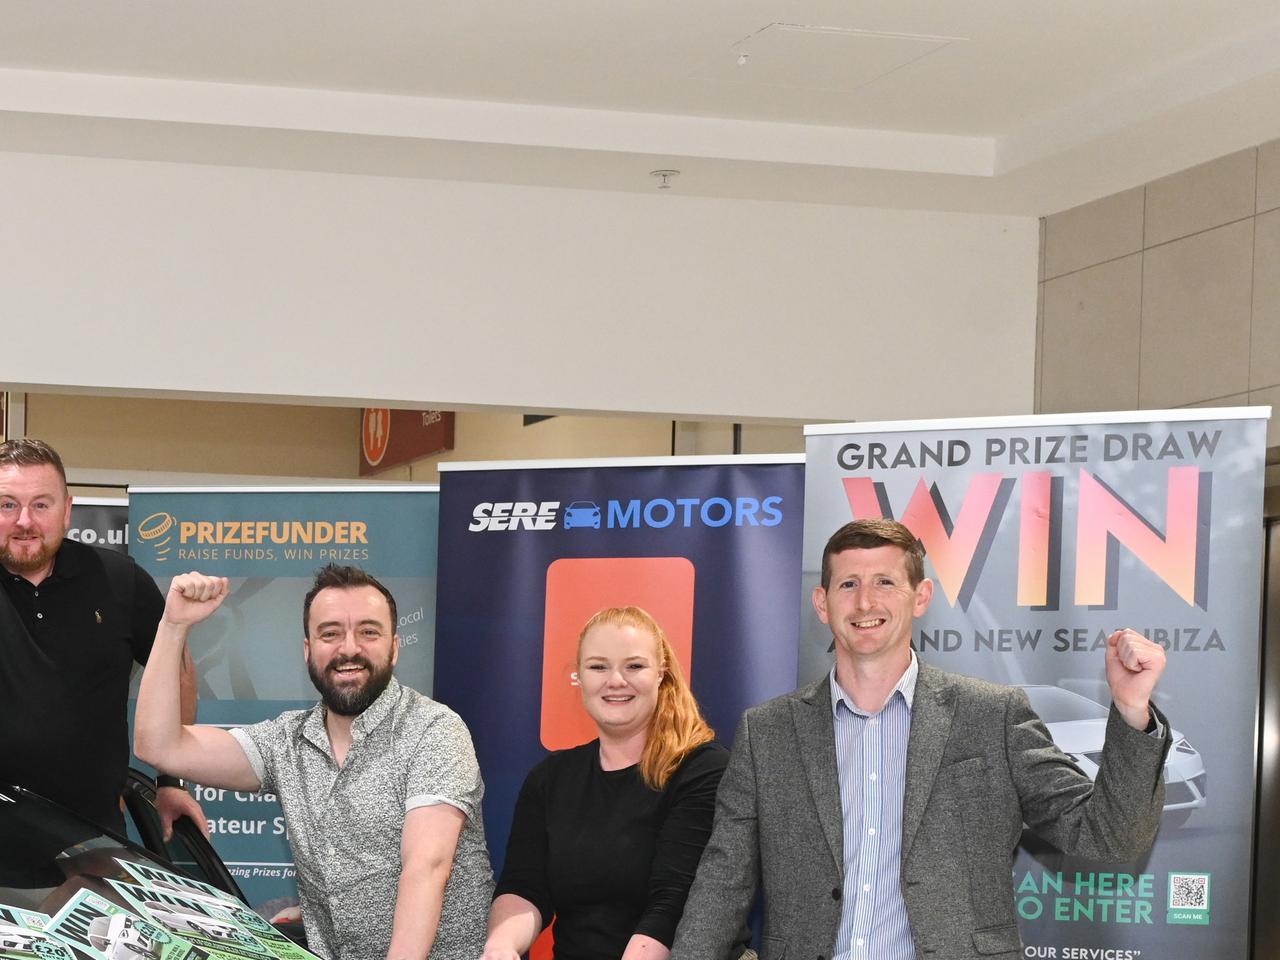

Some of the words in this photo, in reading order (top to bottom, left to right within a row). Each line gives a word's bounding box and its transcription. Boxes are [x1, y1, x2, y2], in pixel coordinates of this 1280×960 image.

[837, 440, 971, 471] GRAND
[985, 435, 1089, 466] PRIZE
[1103, 430, 1223, 462] DRAW
[468, 501, 560, 532] SERE
[607, 496, 783, 529] MOTORS
[180, 521, 368, 545] PRIZEFUNDER
[842, 466, 1213, 613] WIN
[179, 549, 219, 560] RAISE
[224, 549, 277, 561] FUNDS,
[284, 549, 314, 560] WIN
[320, 549, 369, 560] PRIZES
[397, 607, 424, 628] ocal
[975, 629, 1042, 653] NEW
[1052, 628, 1123, 652] SEA
[194, 784, 227, 801] for
[207, 817, 266, 834] ateur
[253, 868, 280, 877] Prizes
[1011, 871, 1063, 896] AN
[1075, 872, 1154, 898] HERE
[1014, 897, 1043, 921] O
[1056, 897, 1153, 925] ENTER
[35, 943, 66, 957] £20
[1024, 945, 1057, 959] OUR
